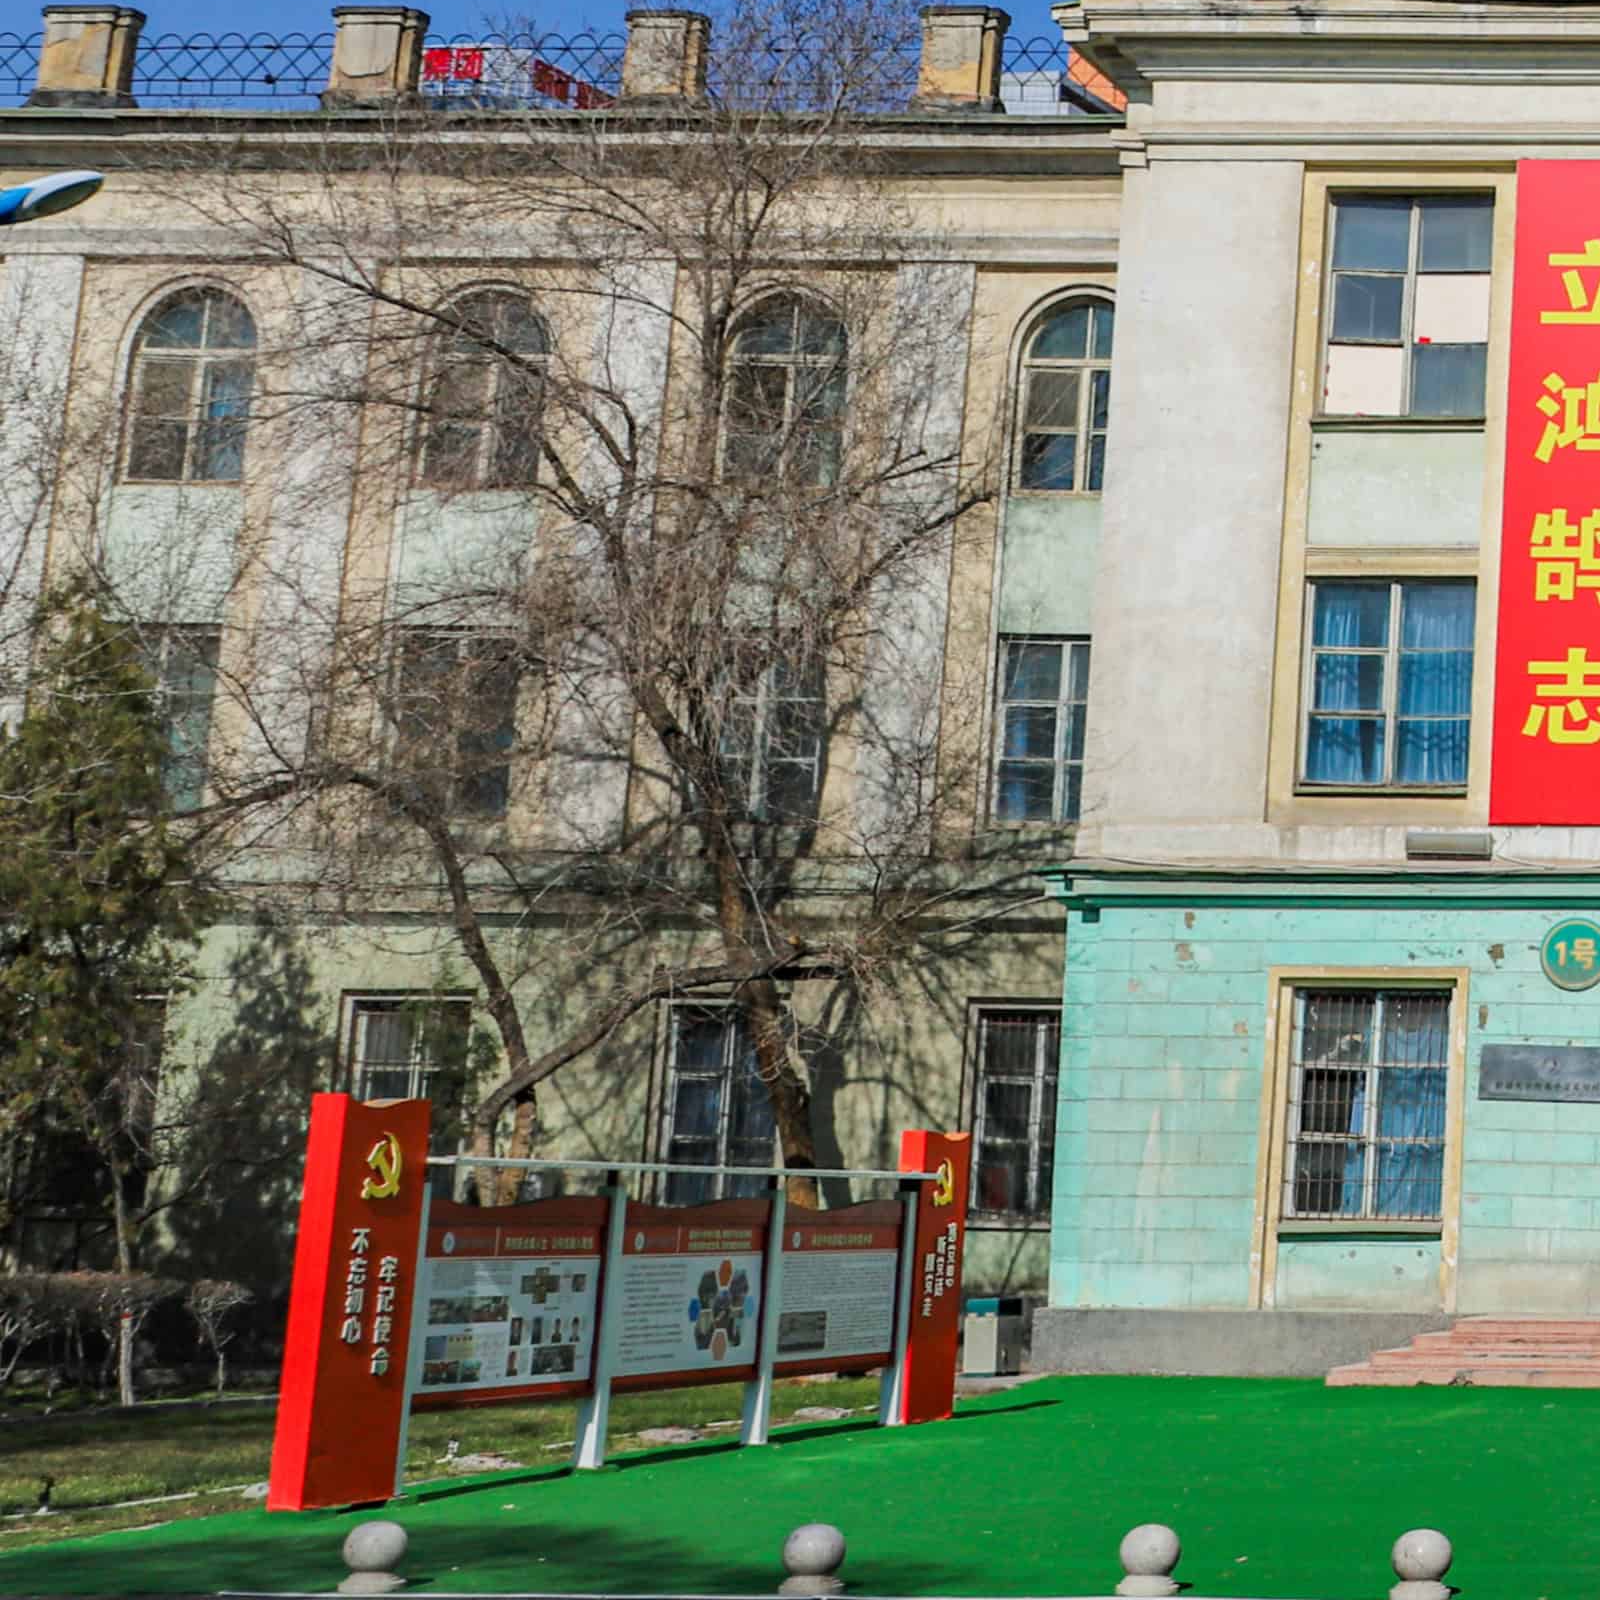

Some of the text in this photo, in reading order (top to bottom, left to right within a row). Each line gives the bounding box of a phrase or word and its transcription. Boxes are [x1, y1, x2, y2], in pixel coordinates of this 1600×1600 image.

[1554, 938, 1598, 971] 1号
[340, 1227, 371, 1344] 不忘初心
[369, 1255, 399, 1377] 牢记使命
